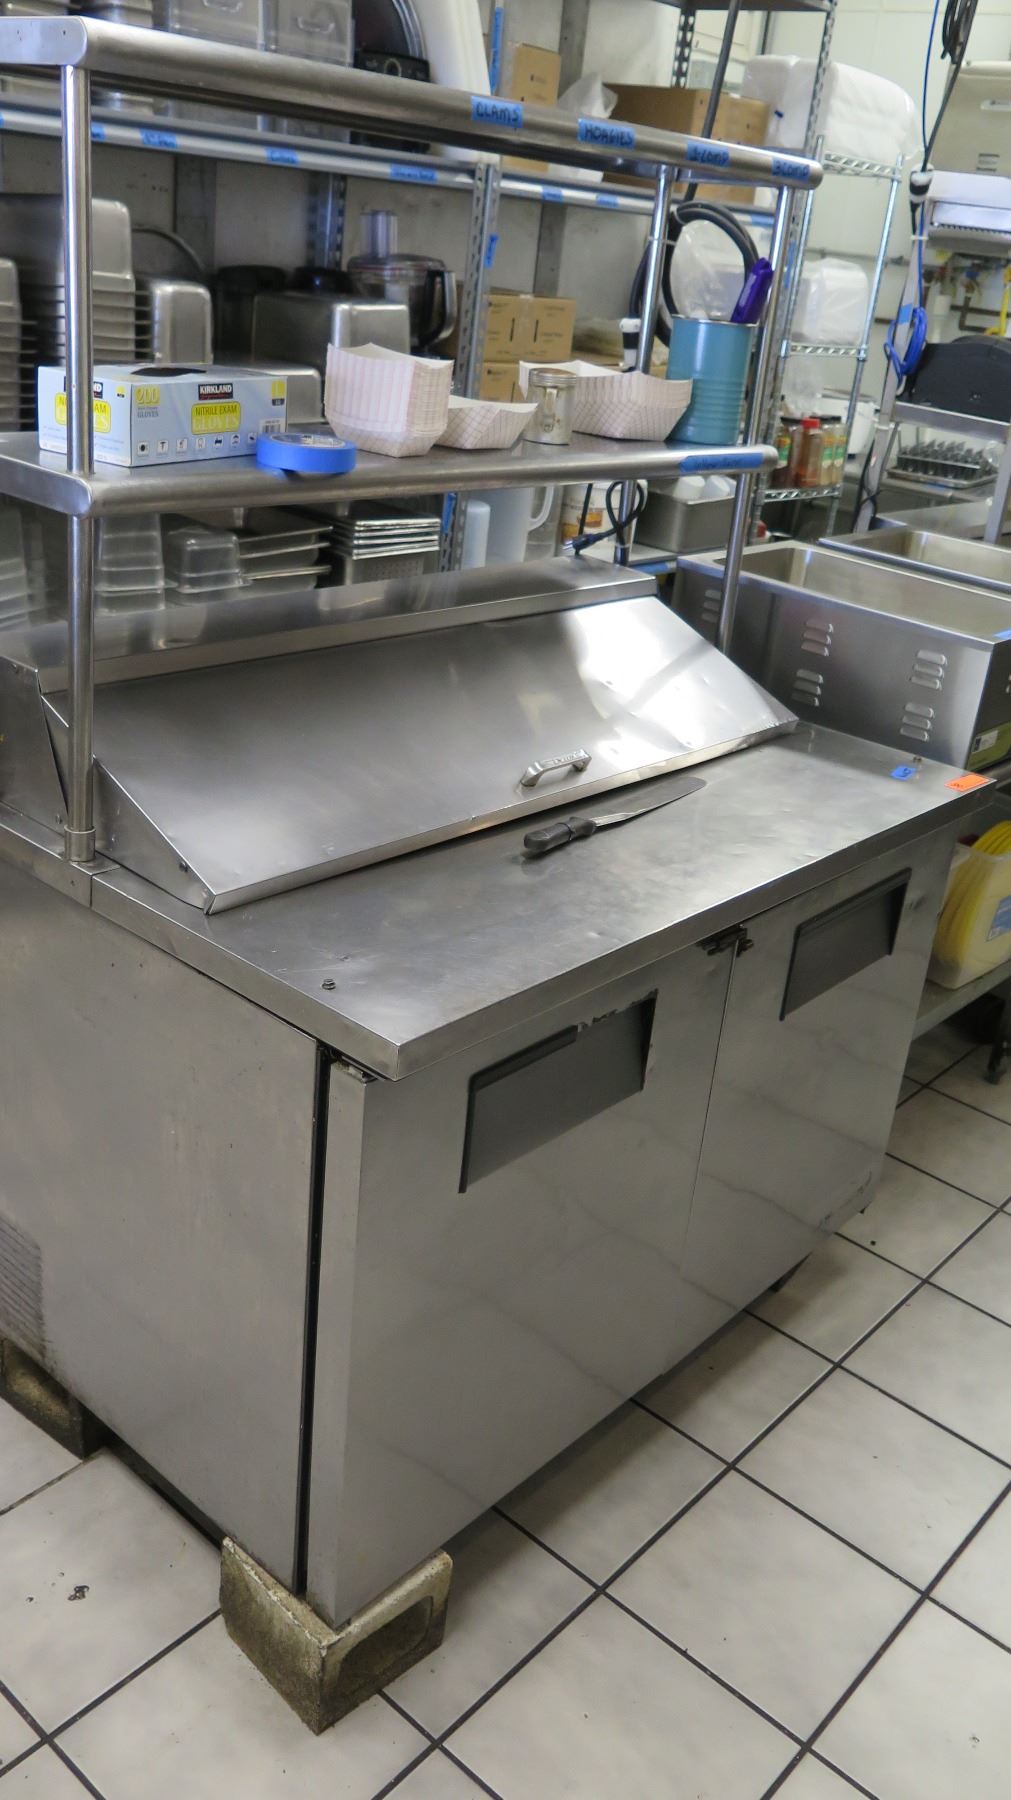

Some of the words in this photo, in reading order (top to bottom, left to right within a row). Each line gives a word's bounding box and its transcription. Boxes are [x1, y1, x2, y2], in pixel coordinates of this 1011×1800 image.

[475, 101, 519, 122] CLAMS
[584, 124, 633, 146] HOAGIES
[200, 384, 232, 394] KIRKLAND
[195, 405, 218, 416] NITRILE
[219, 404, 238, 414] EXAM
[193, 414, 239, 430] GLOVES
